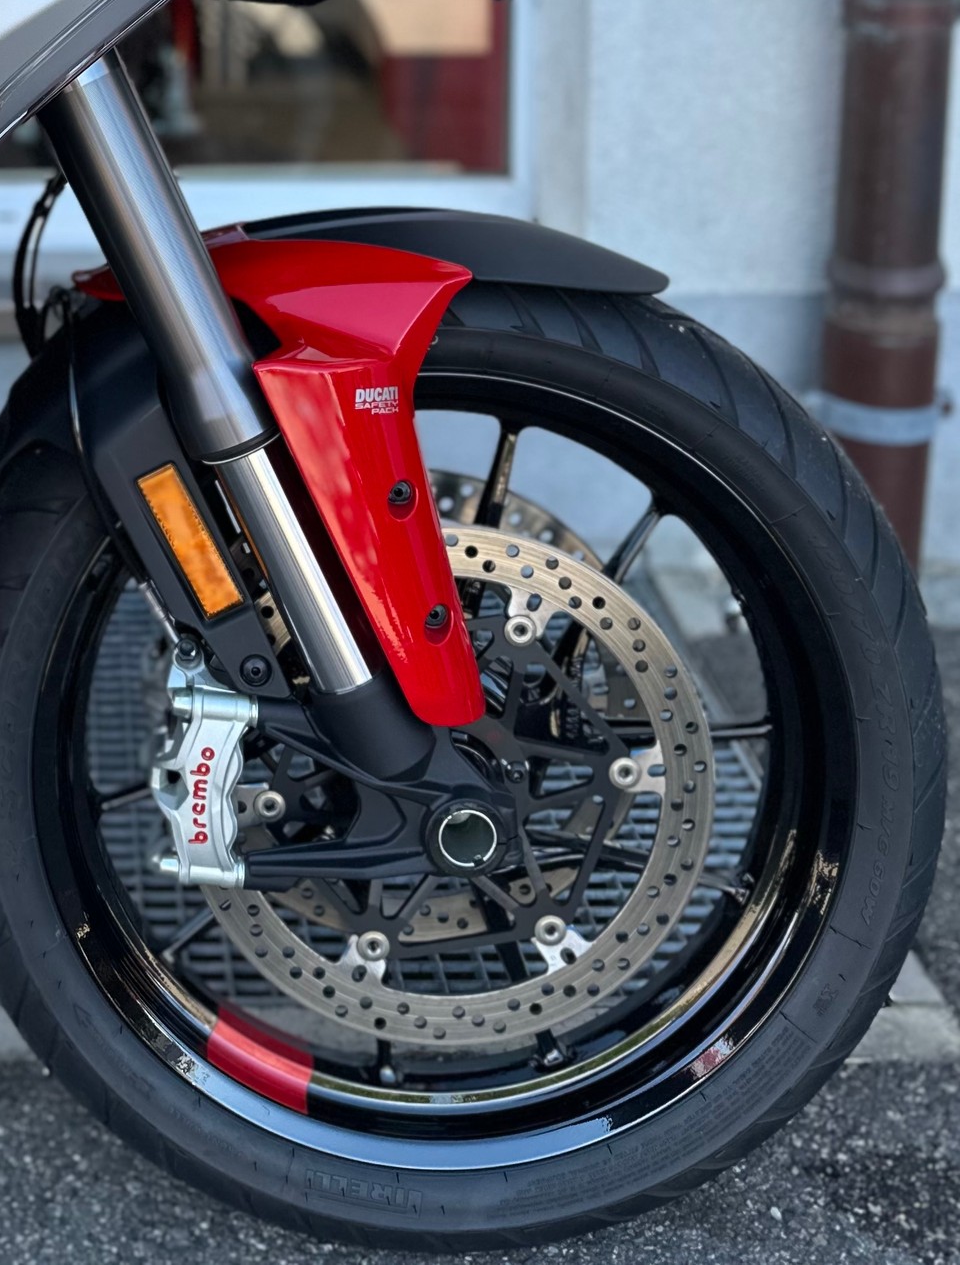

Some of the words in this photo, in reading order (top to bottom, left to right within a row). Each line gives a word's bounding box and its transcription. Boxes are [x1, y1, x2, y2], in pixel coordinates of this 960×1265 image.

[354, 386, 399, 403] DUCATI
[354, 399, 399, 410] SAFETY
[371, 407, 400, 415] PACK
[188, 746, 216, 845] brembo
[304, 1169, 422, 1215] PIRELLI
